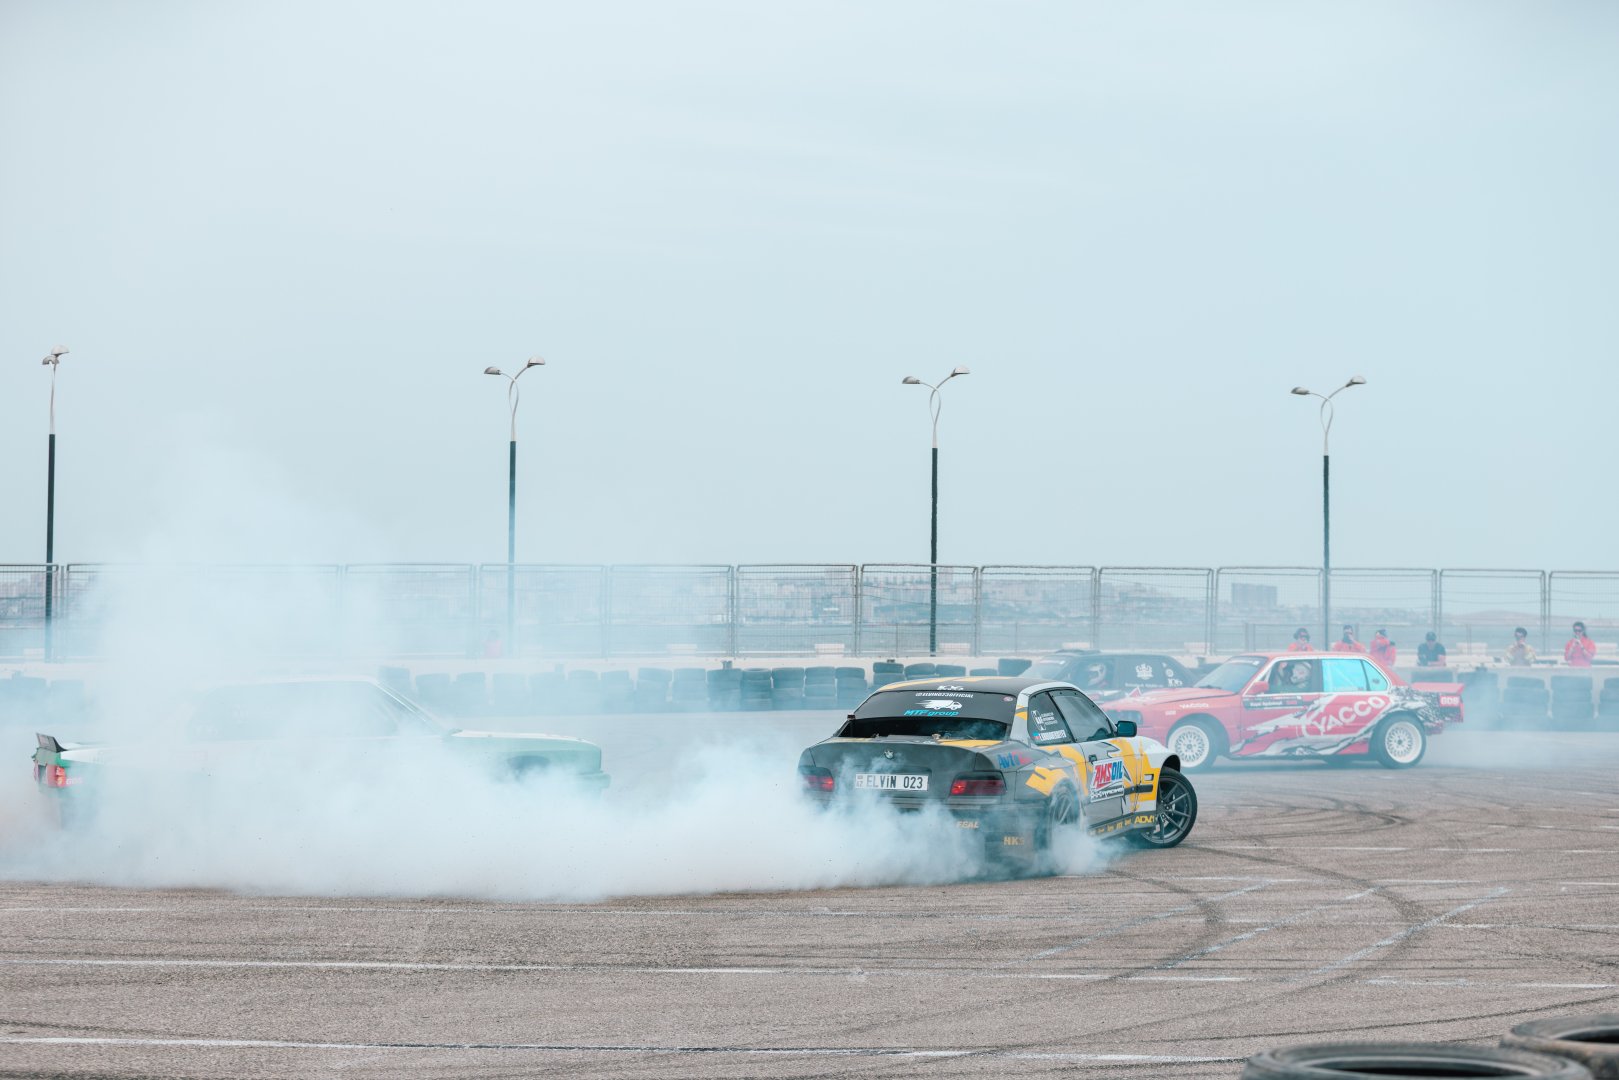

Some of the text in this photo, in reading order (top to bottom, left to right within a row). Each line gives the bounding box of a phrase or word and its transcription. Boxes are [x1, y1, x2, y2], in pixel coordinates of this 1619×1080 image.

[1313, 696, 1385, 735] YACCO
[903, 776, 923, 789] 023
[1093, 761, 1122, 789] AMSOIL
